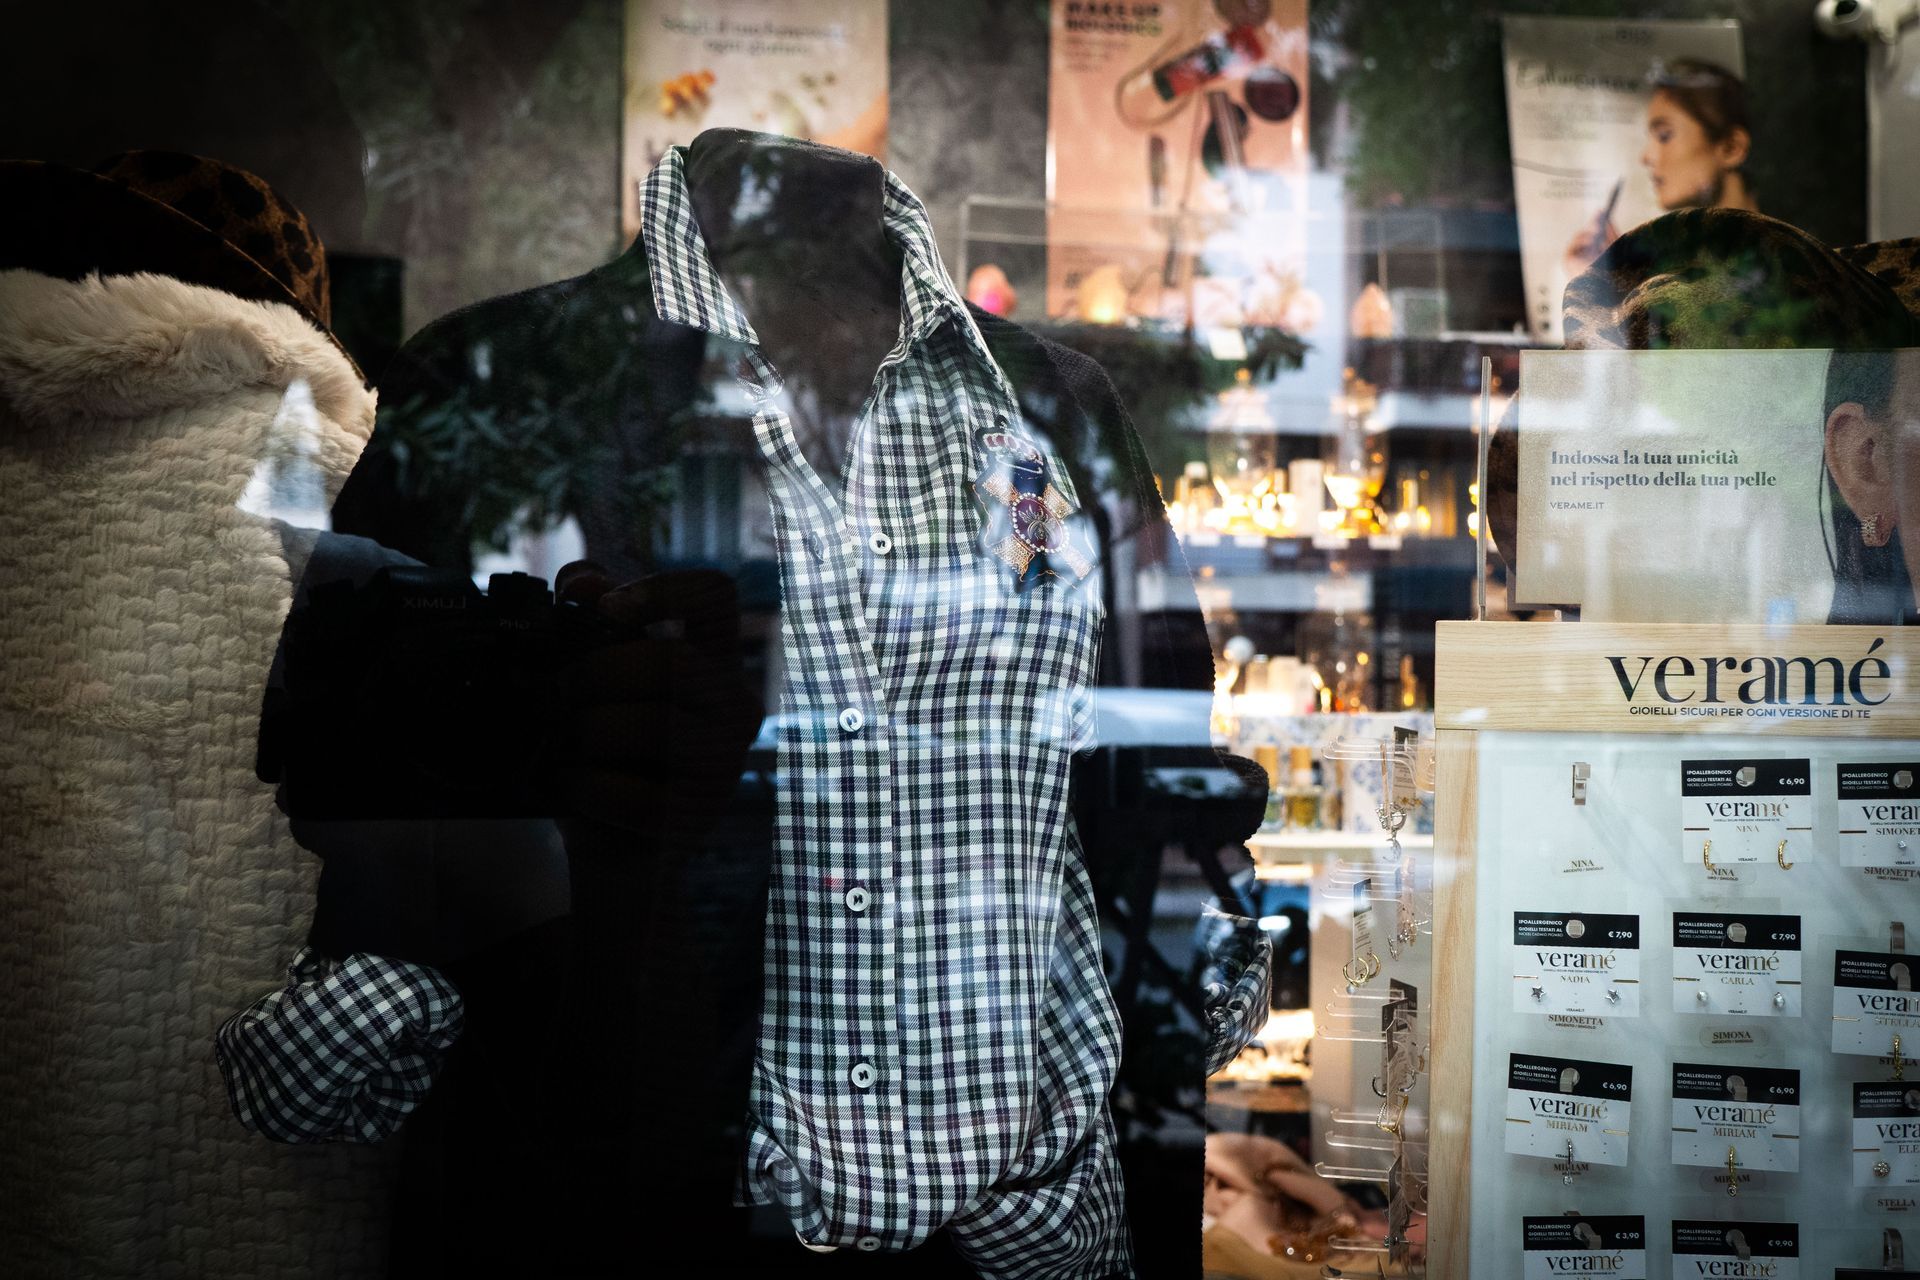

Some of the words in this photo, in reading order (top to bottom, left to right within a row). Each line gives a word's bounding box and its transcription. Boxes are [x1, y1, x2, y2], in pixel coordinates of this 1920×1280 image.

[1551, 451, 1619, 465] Indossa
[1624, 450, 1638, 465] la
[1644, 451, 1672, 465] tua
[1676, 450, 1739, 465] unicità
[1550, 472, 1577, 486] nel
[1581, 472, 1649, 489] rispetto
[1654, 472, 1696, 486] della
[1701, 473, 1729, 487] tua
[1733, 472, 1777, 489] pelle
[1550, 502, 1604, 510] VERAME.IT
[1605, 637, 1891, 705] veramé
[1630, 706, 1677, 715] GIOIELLI
[1680, 707, 1717, 716] SICURI
[1721, 708, 1743, 717] PER
[1747, 708, 1776, 717] OGNI
[1779, 709, 1839, 718] VERSIONE
[1842, 709, 1853, 718] DI
[1855, 710, 1870, 718] TE
[1786, 778, 1805, 786] 6,90
[1705, 797, 1789, 817] veramé
[1862, 805, 1920, 820] vera
[1536, 950, 1616, 969] veramé
[1697, 951, 1779, 971] veramé
[1561, 975, 1590, 983] NADIA
[1721, 977, 1754, 985] CARLA
[1548, 1014, 1603, 1025] SIMONETTA
[1713, 1031, 1751, 1039] SIMONA
[1514, 1064, 1557, 1072] IPOALLERGENICO
[1609, 1083, 1627, 1091] 6,90
[1776, 1087, 1794, 1095] 6,90
[1528, 1097, 1608, 1119] veramé
[1693, 1105, 1776, 1124] veramé
[1546, 1120, 1588, 1133] MIRIAM
[1713, 1127, 1756, 1138] MIRIAM
[1878, 1199, 1916, 1207] STELLA
[1545, 1250, 1624, 1271] veramé
[1696, 1258, 1777, 1277] veramé
